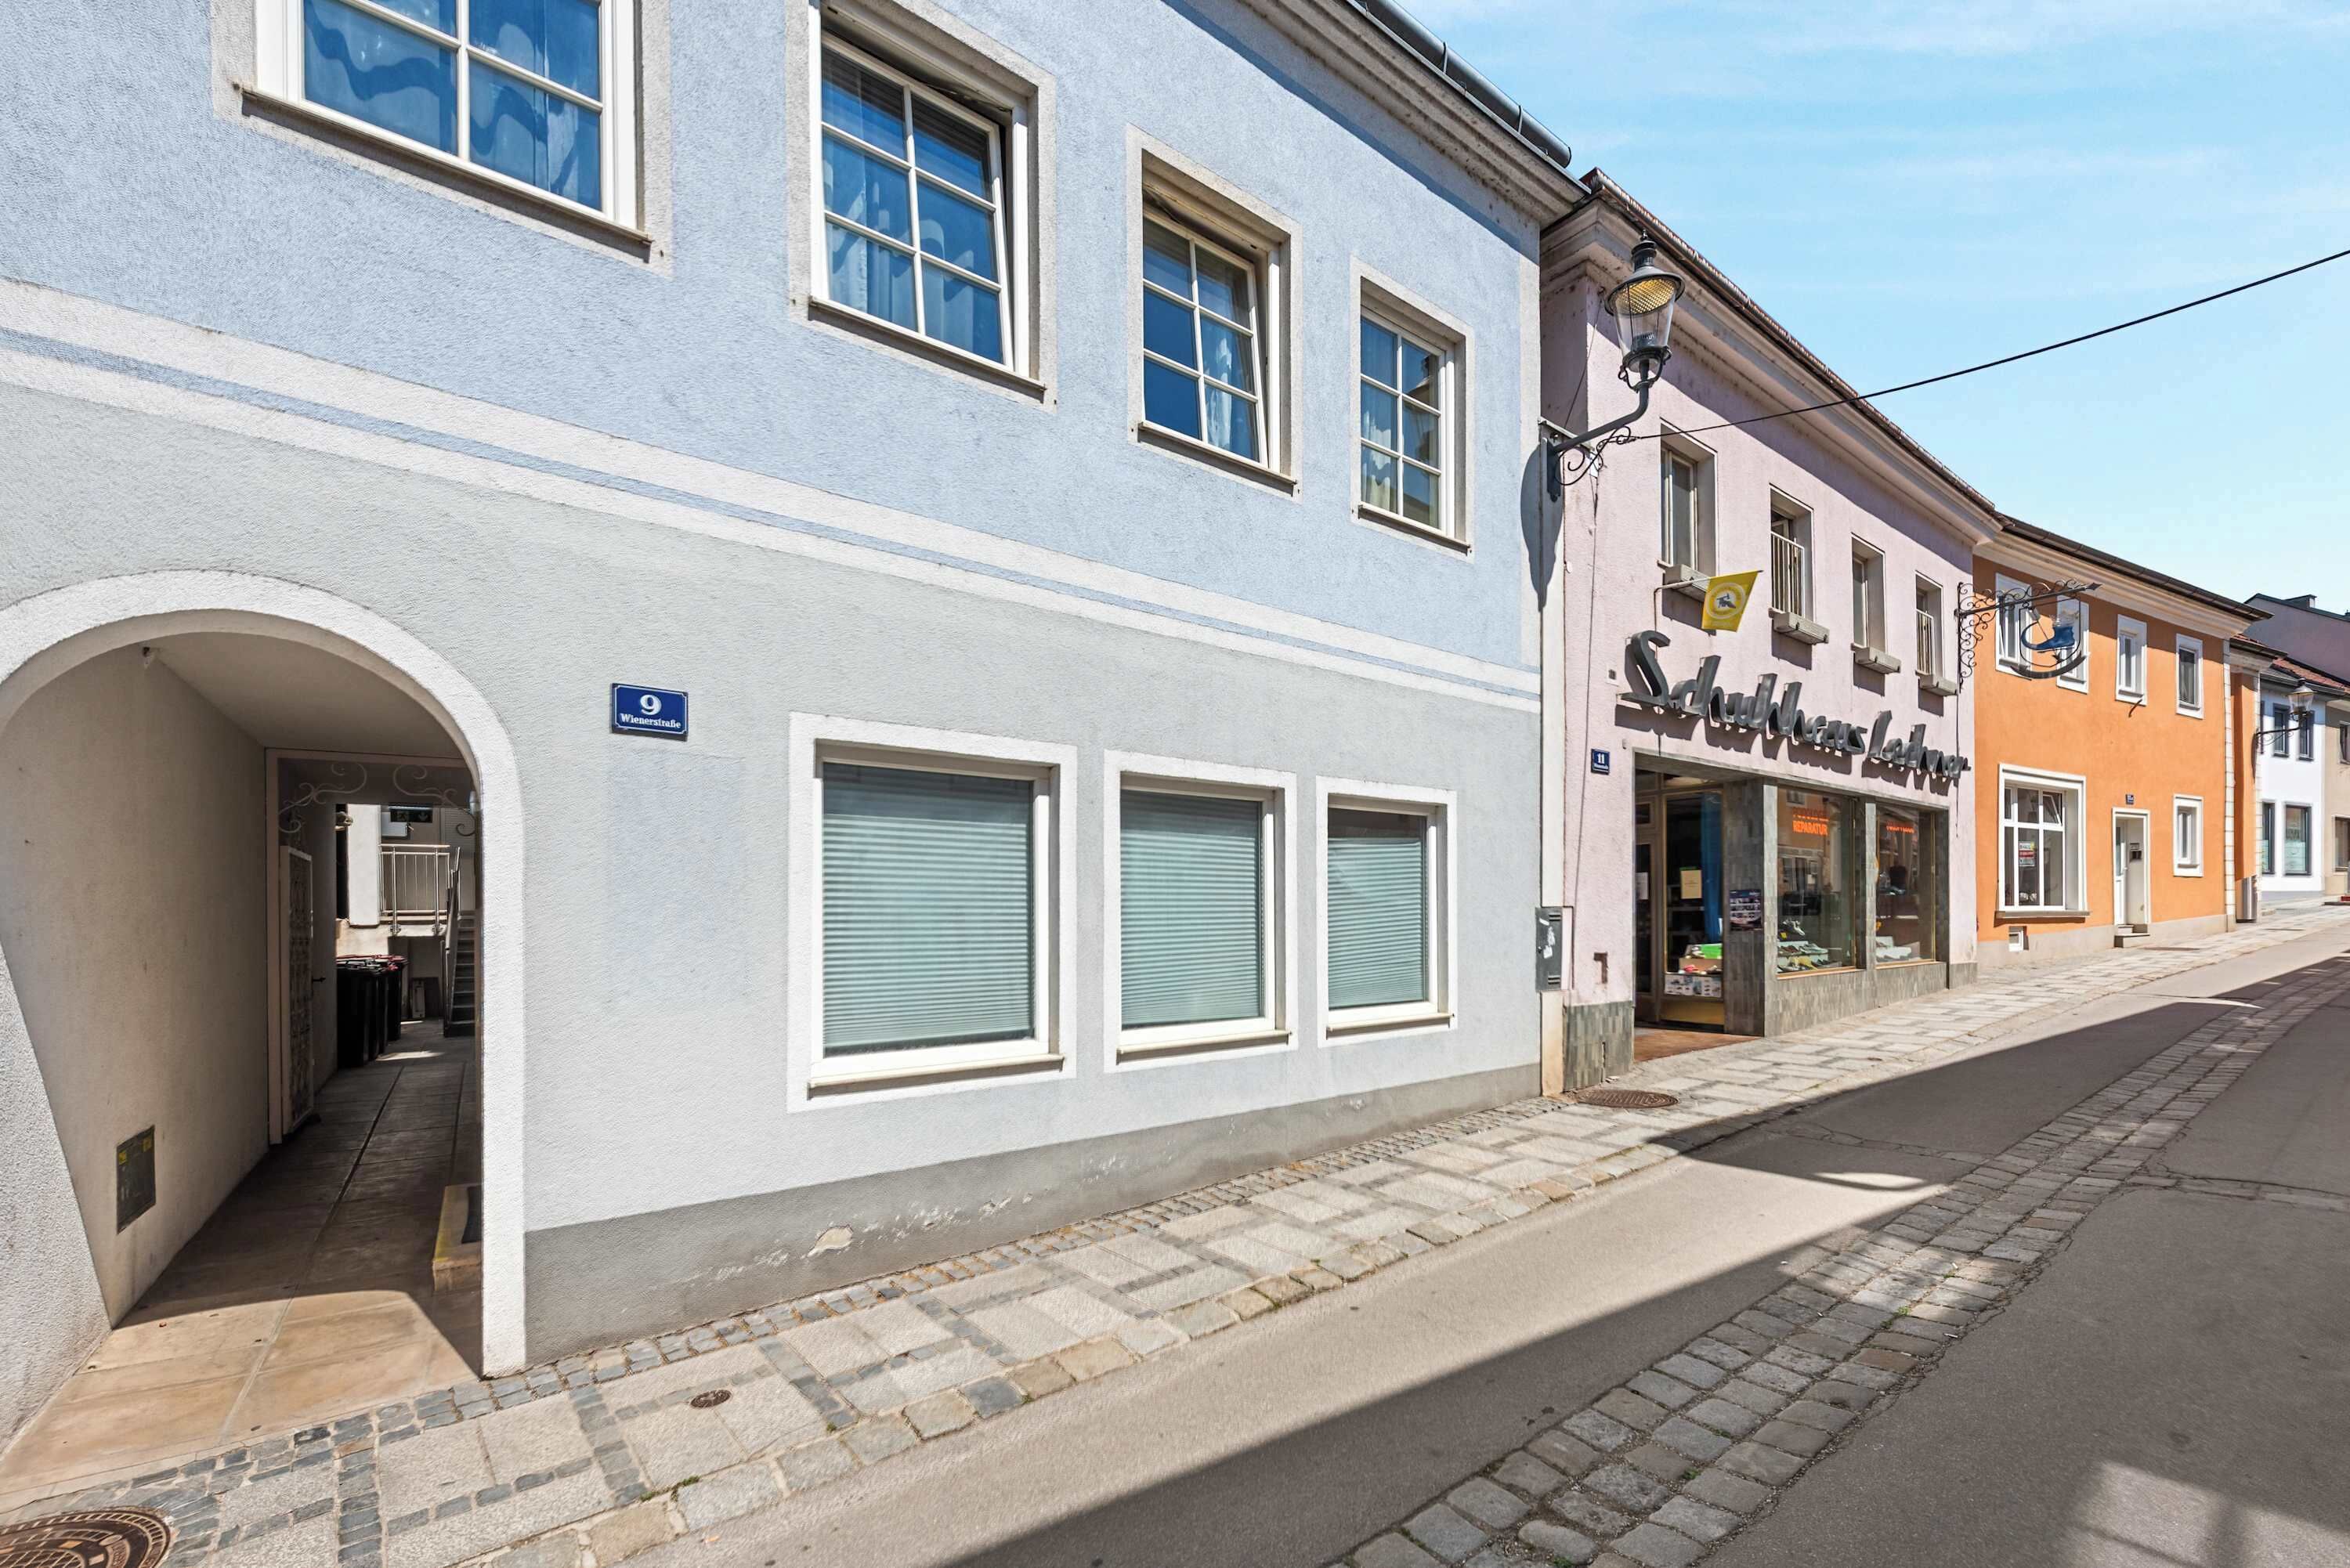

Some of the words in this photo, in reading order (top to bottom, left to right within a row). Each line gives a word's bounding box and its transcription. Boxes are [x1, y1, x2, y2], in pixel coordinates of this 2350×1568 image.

[640, 694, 662, 716] 9
[620, 713, 682, 728] Wienerstraße
[1597, 753, 1605, 764] 11
[1792, 820, 1828, 836] REPARATUR
